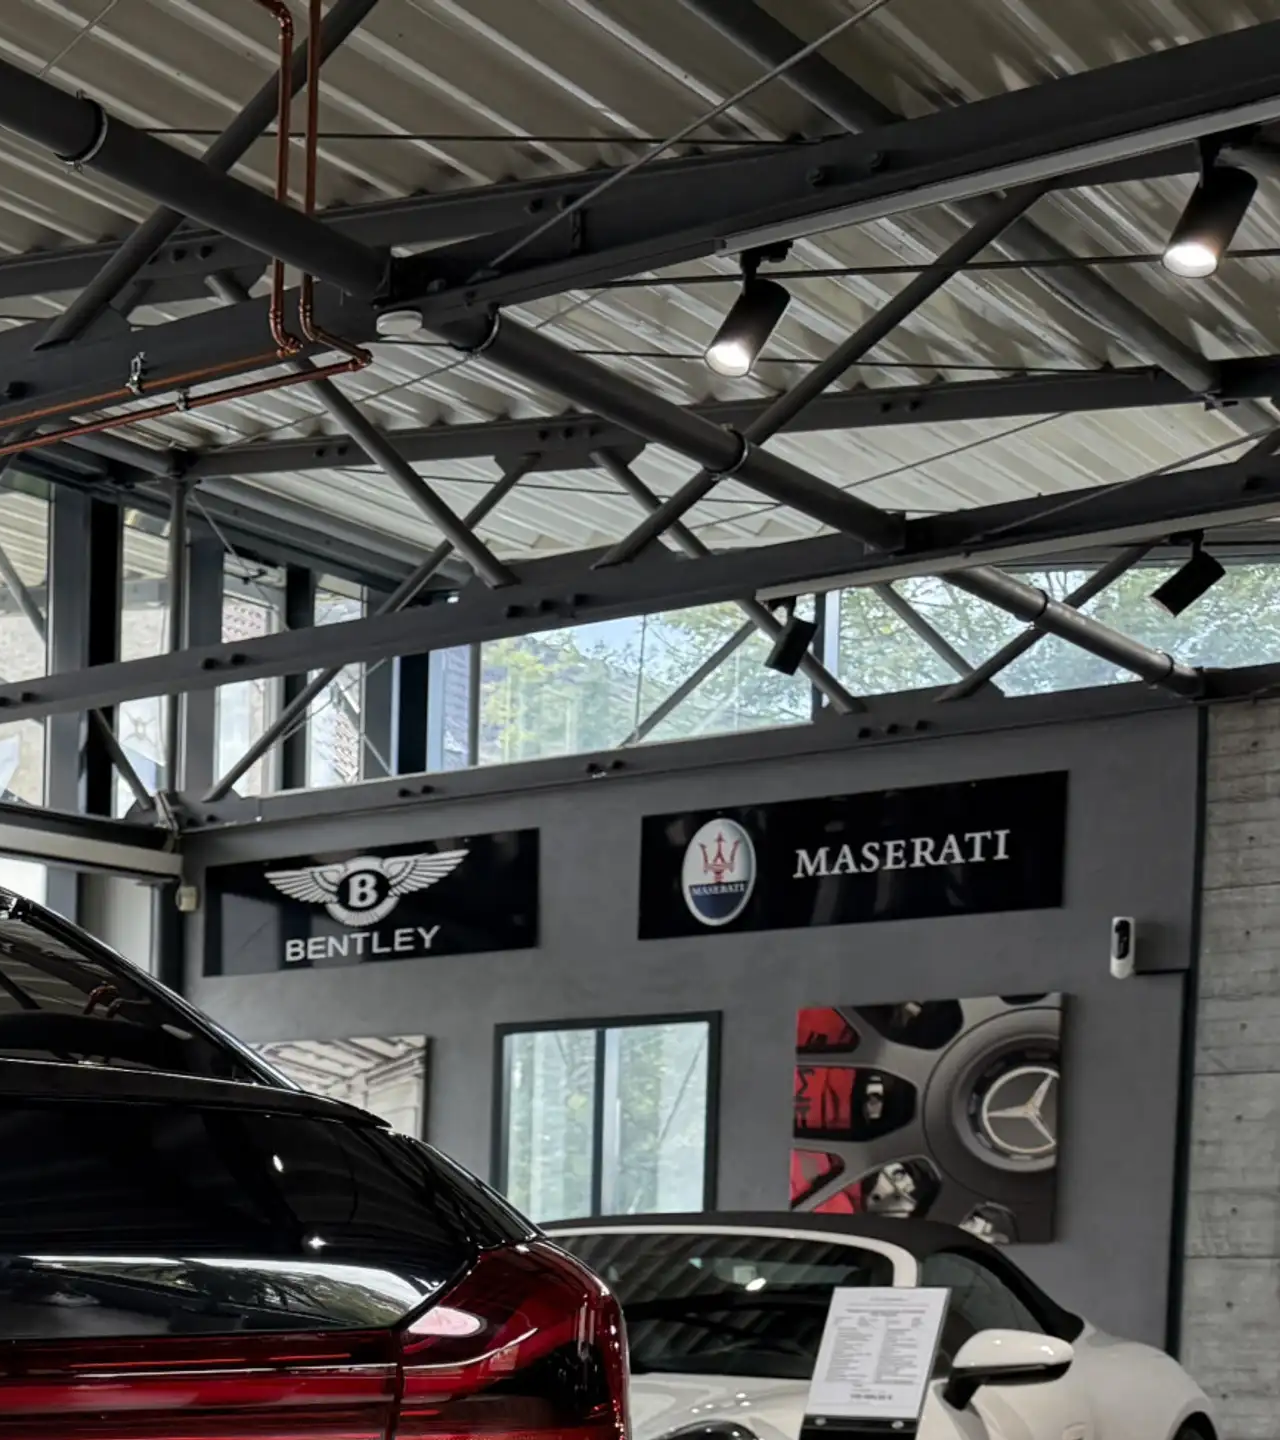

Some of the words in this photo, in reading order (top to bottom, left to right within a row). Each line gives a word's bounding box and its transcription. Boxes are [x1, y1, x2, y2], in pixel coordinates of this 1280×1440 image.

[793, 829, 1011, 879] MASERATI
[349, 873, 379, 908] B
[691, 883, 745, 896] MASERATI
[285, 925, 440, 962] BENTLEY
